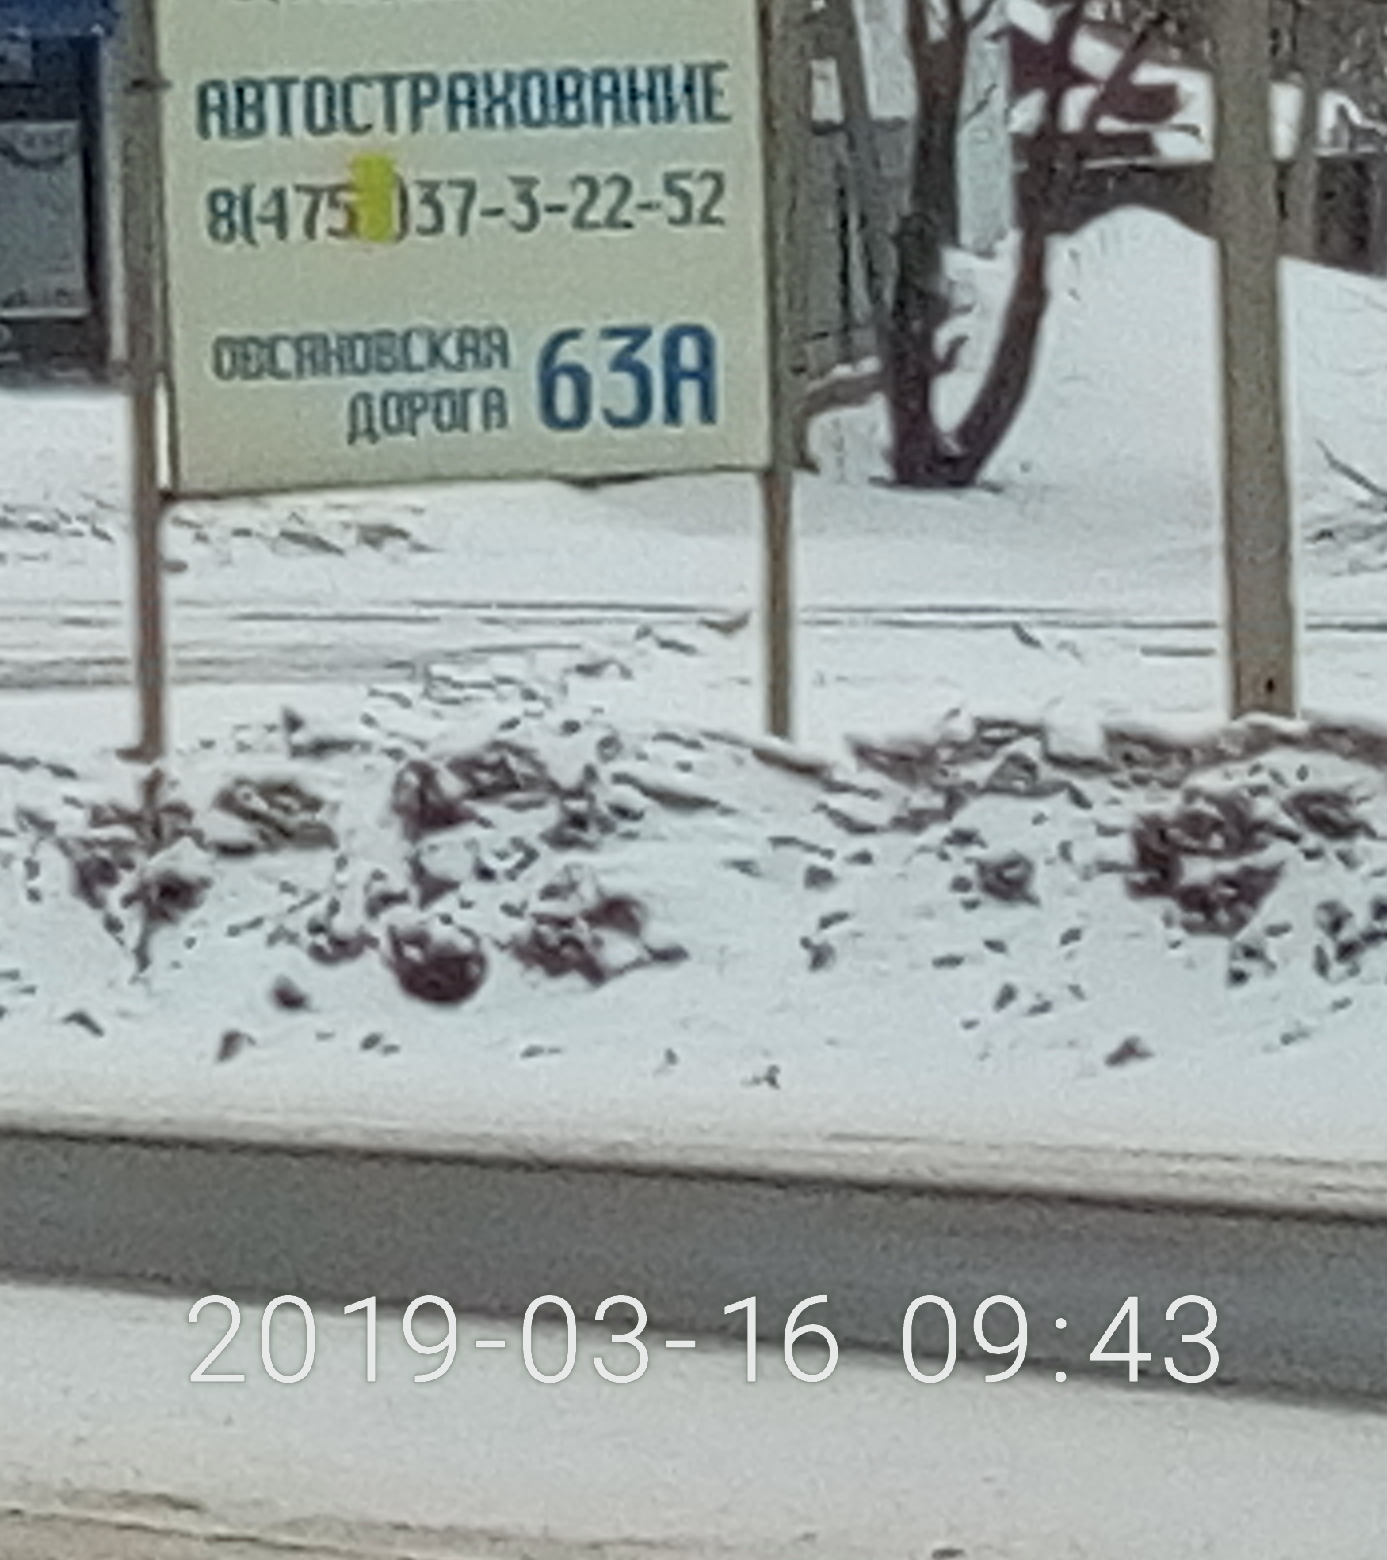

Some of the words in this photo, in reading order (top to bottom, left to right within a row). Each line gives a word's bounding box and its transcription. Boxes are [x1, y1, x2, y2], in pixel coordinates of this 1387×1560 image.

[195, 61, 732, 140] АВТОСТРАХОВАНИЕ
[205, 169, 727, 248] 8(475)37-3-22-52
[346, 387, 510, 446] ДОРОГА
[536, 322, 719, 432] 63А
